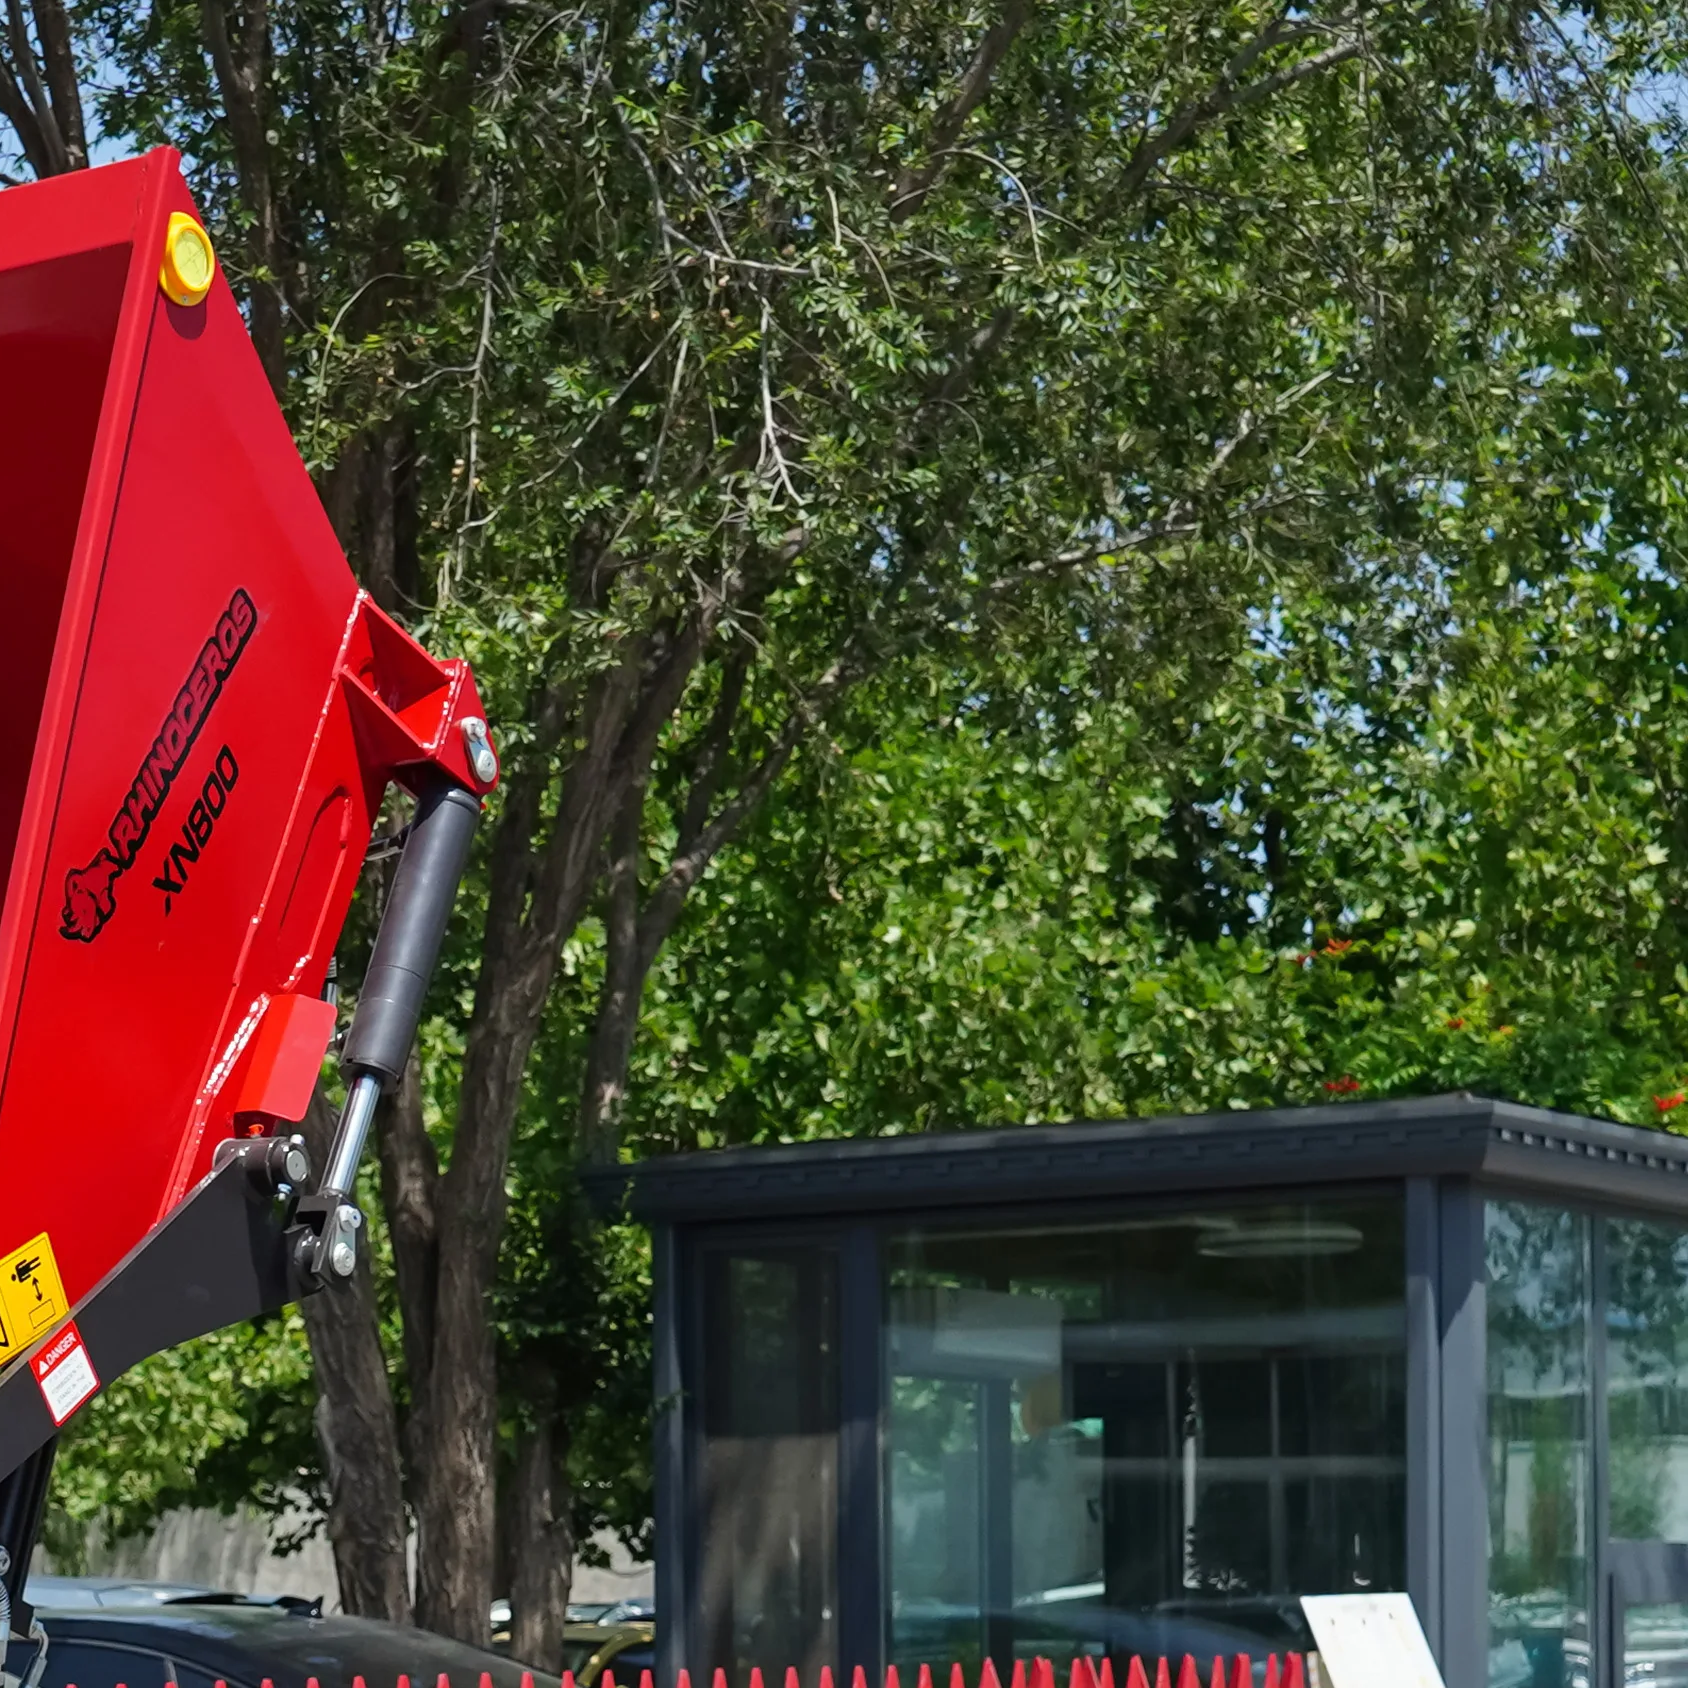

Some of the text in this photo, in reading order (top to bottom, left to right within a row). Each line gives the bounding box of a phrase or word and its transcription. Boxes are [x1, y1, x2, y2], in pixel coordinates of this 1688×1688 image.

[110, 588, 256, 868] RHINOCEROS
[152, 744, 239, 915] XN800
[45, 1332, 77, 1366] DANGER
